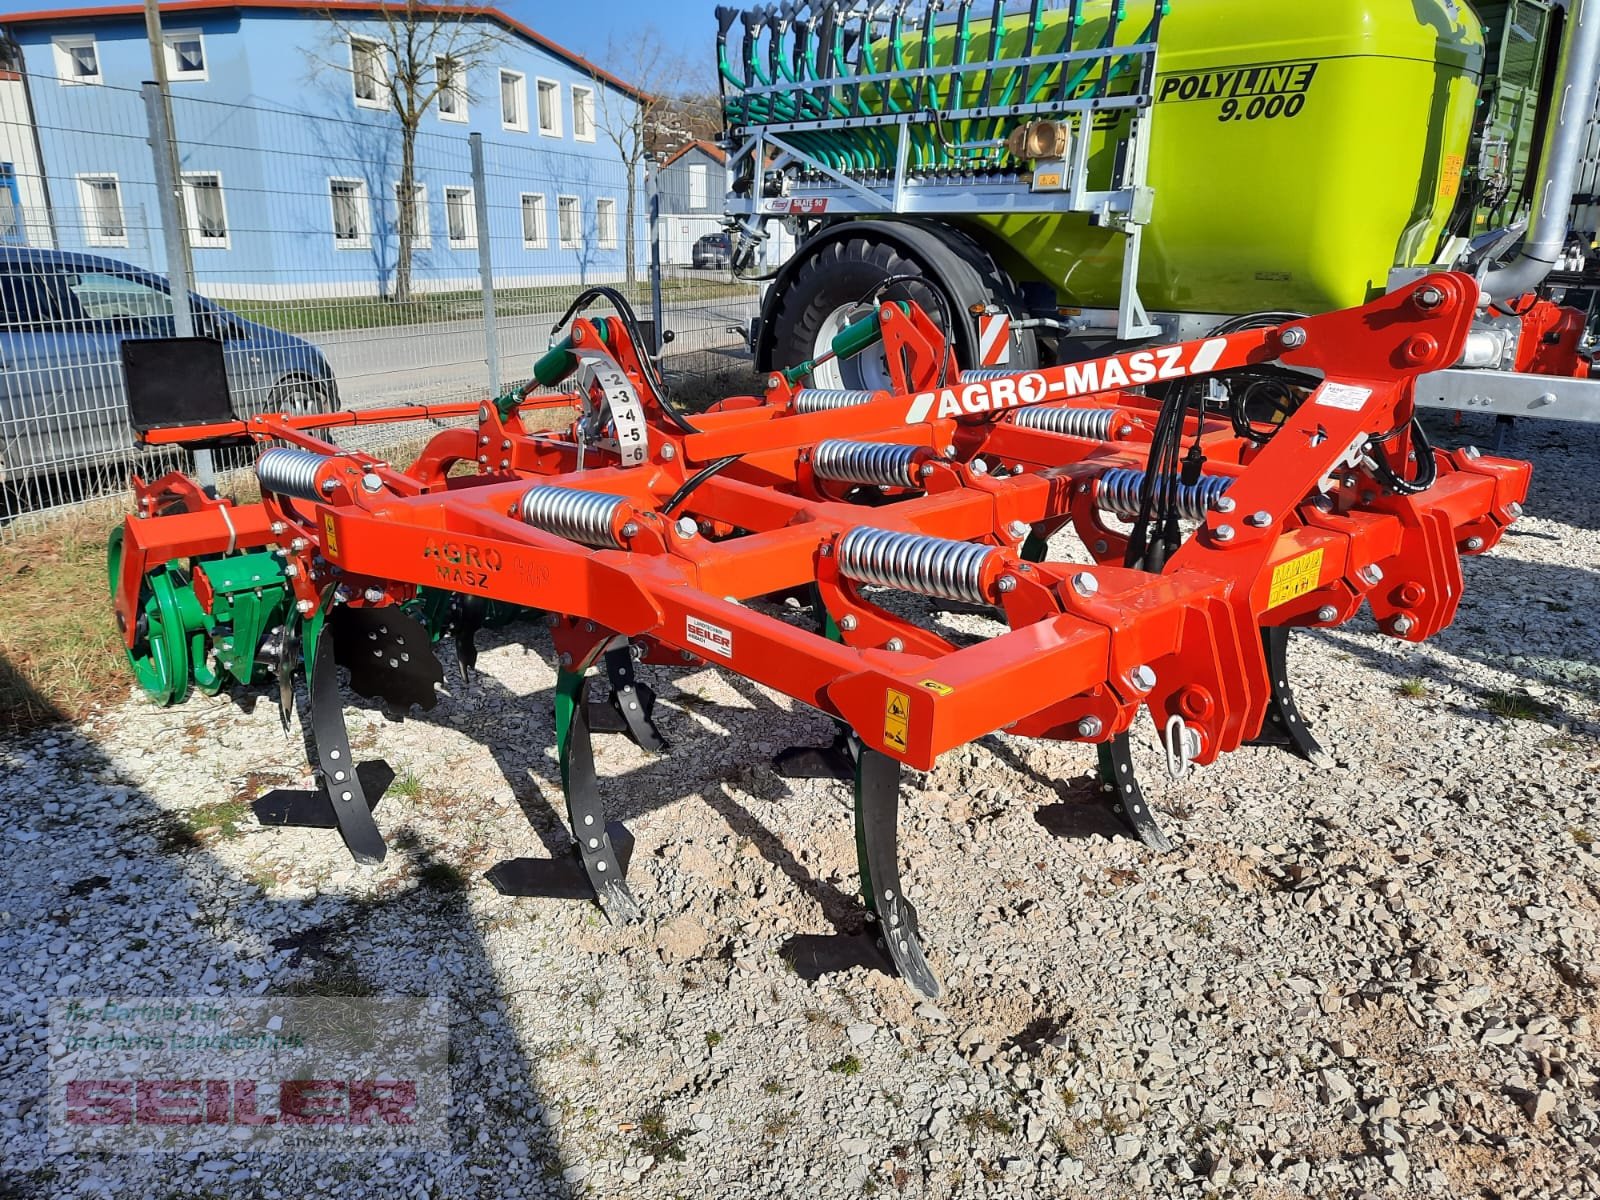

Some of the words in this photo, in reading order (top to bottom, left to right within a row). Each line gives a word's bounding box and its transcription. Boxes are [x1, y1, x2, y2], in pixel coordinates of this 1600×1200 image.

[1158, 64, 1316, 102] POLYLINE
[1218, 94, 1305, 122] 9.000
[793, 199, 812, 207] SKATE
[937, 345, 1185, 419] AGRO-MASZ
[423, 537, 503, 572] AGRO
[436, 565, 489, 589] MASZ
[688, 623, 730, 648] SEILER
